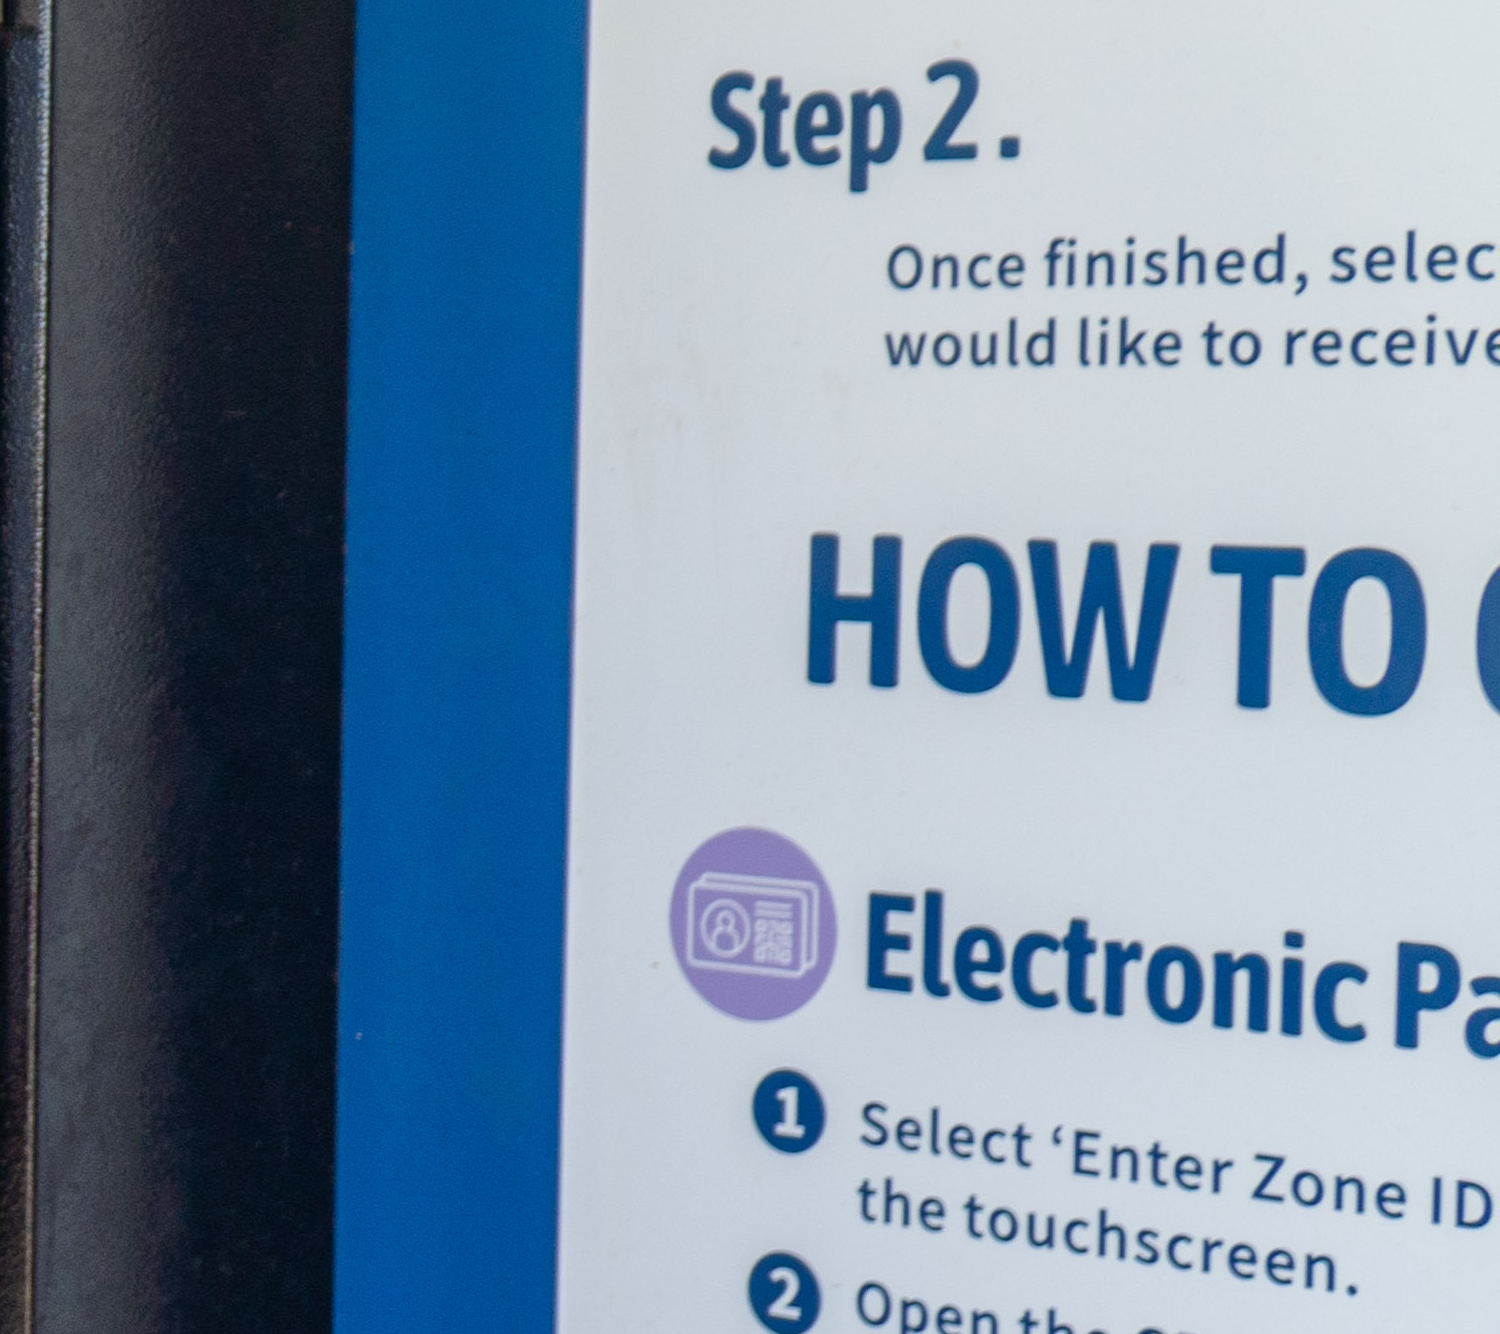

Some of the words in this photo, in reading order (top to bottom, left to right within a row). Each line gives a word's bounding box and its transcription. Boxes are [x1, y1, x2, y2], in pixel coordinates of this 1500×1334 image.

[707, 71, 902, 194] Step
[922, 59, 1020, 162] 2.
[887, 244, 1026, 291] Once
[1044, 232, 1308, 296] finished,
[1330, 229, 1496, 284] selec
[884, 317, 1057, 368] would
[1078, 316, 1183, 368] like
[1201, 321, 1262, 367] to
[1284, 313, 1500, 367] receive
[806, 533, 1180, 703] HOW
[1209, 544, 1427, 717] TO
[866, 889, 1368, 1044] Electronic
[773, 1084, 805, 1140] 1
[860, 1101, 1032, 1169] Select
[1251, 1153, 1407, 1220] Zone
[1431, 1176, 1493, 1230] ID
[767, 1268, 801, 1320] 2
[857, 1177, 946, 1233] the
[963, 1195, 1358, 1297] touchscreen.
